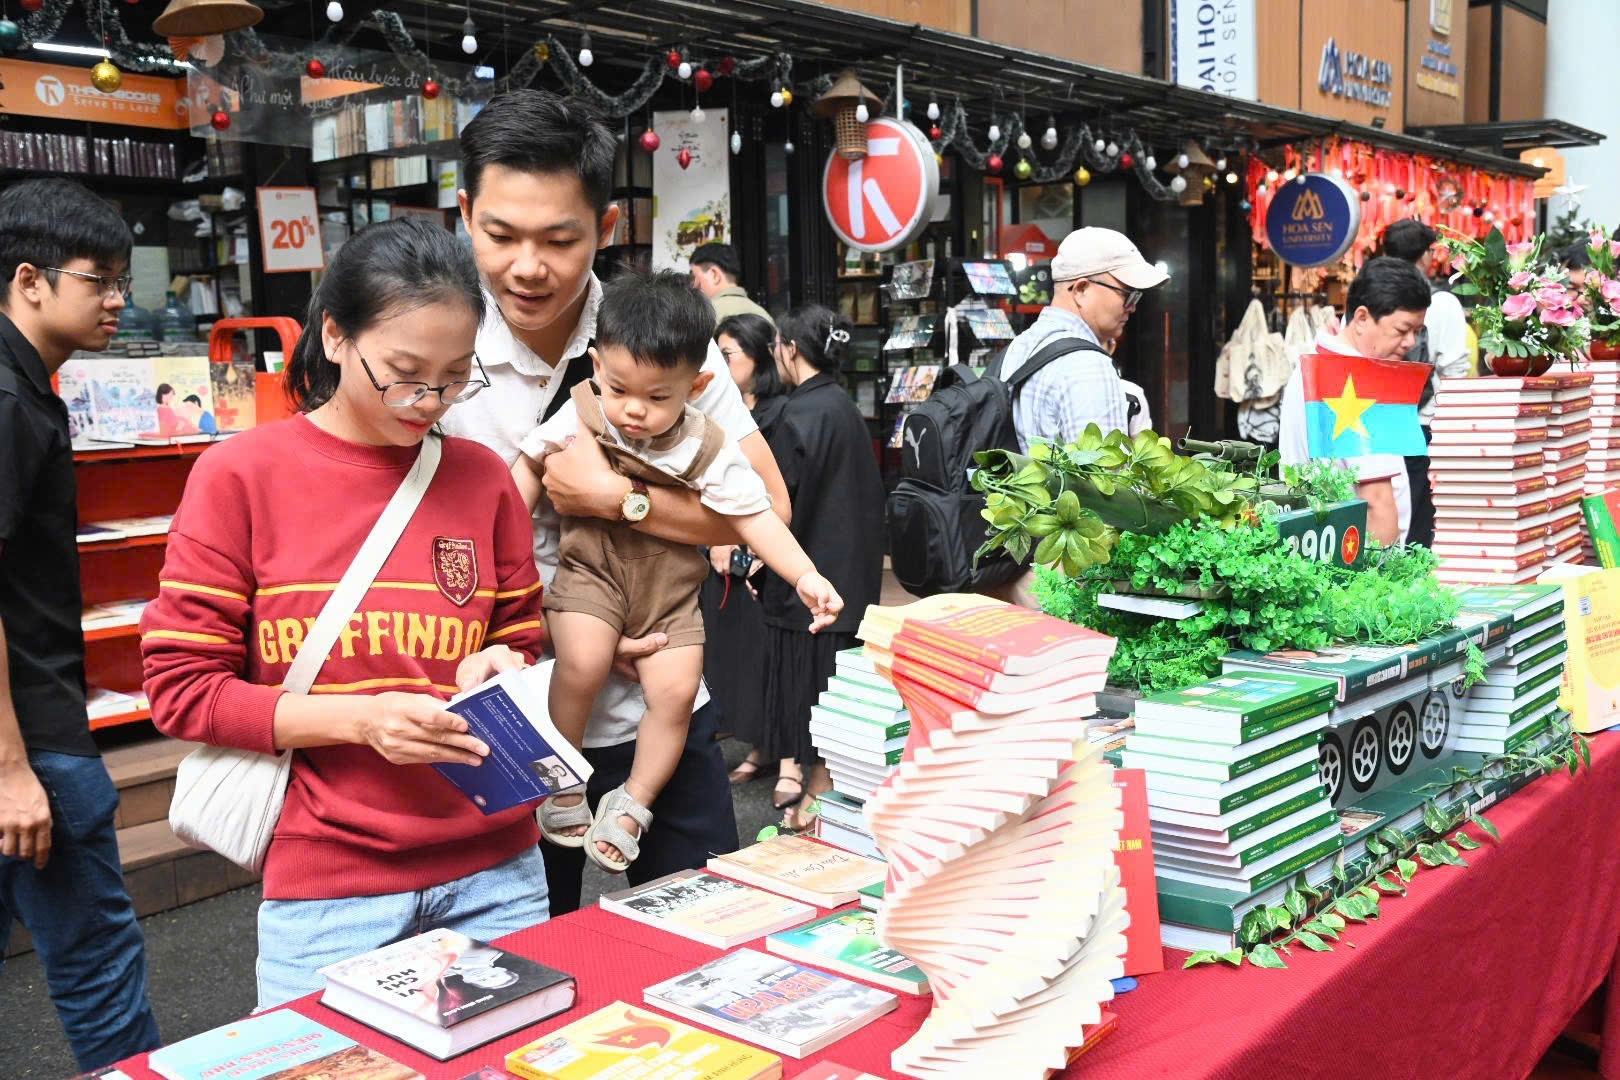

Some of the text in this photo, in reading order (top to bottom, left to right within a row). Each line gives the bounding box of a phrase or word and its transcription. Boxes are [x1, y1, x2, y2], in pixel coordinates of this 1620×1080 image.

[1197, 0, 1221, 48] HỌ
[74, 97, 159, 113] Serve to Lead
[271, 215, 316, 249] 20%
[1282, 222, 1334, 233] HOA SEN
[258, 610, 489, 664] GRFFINDO
[376, 968, 417, 986] HUY
